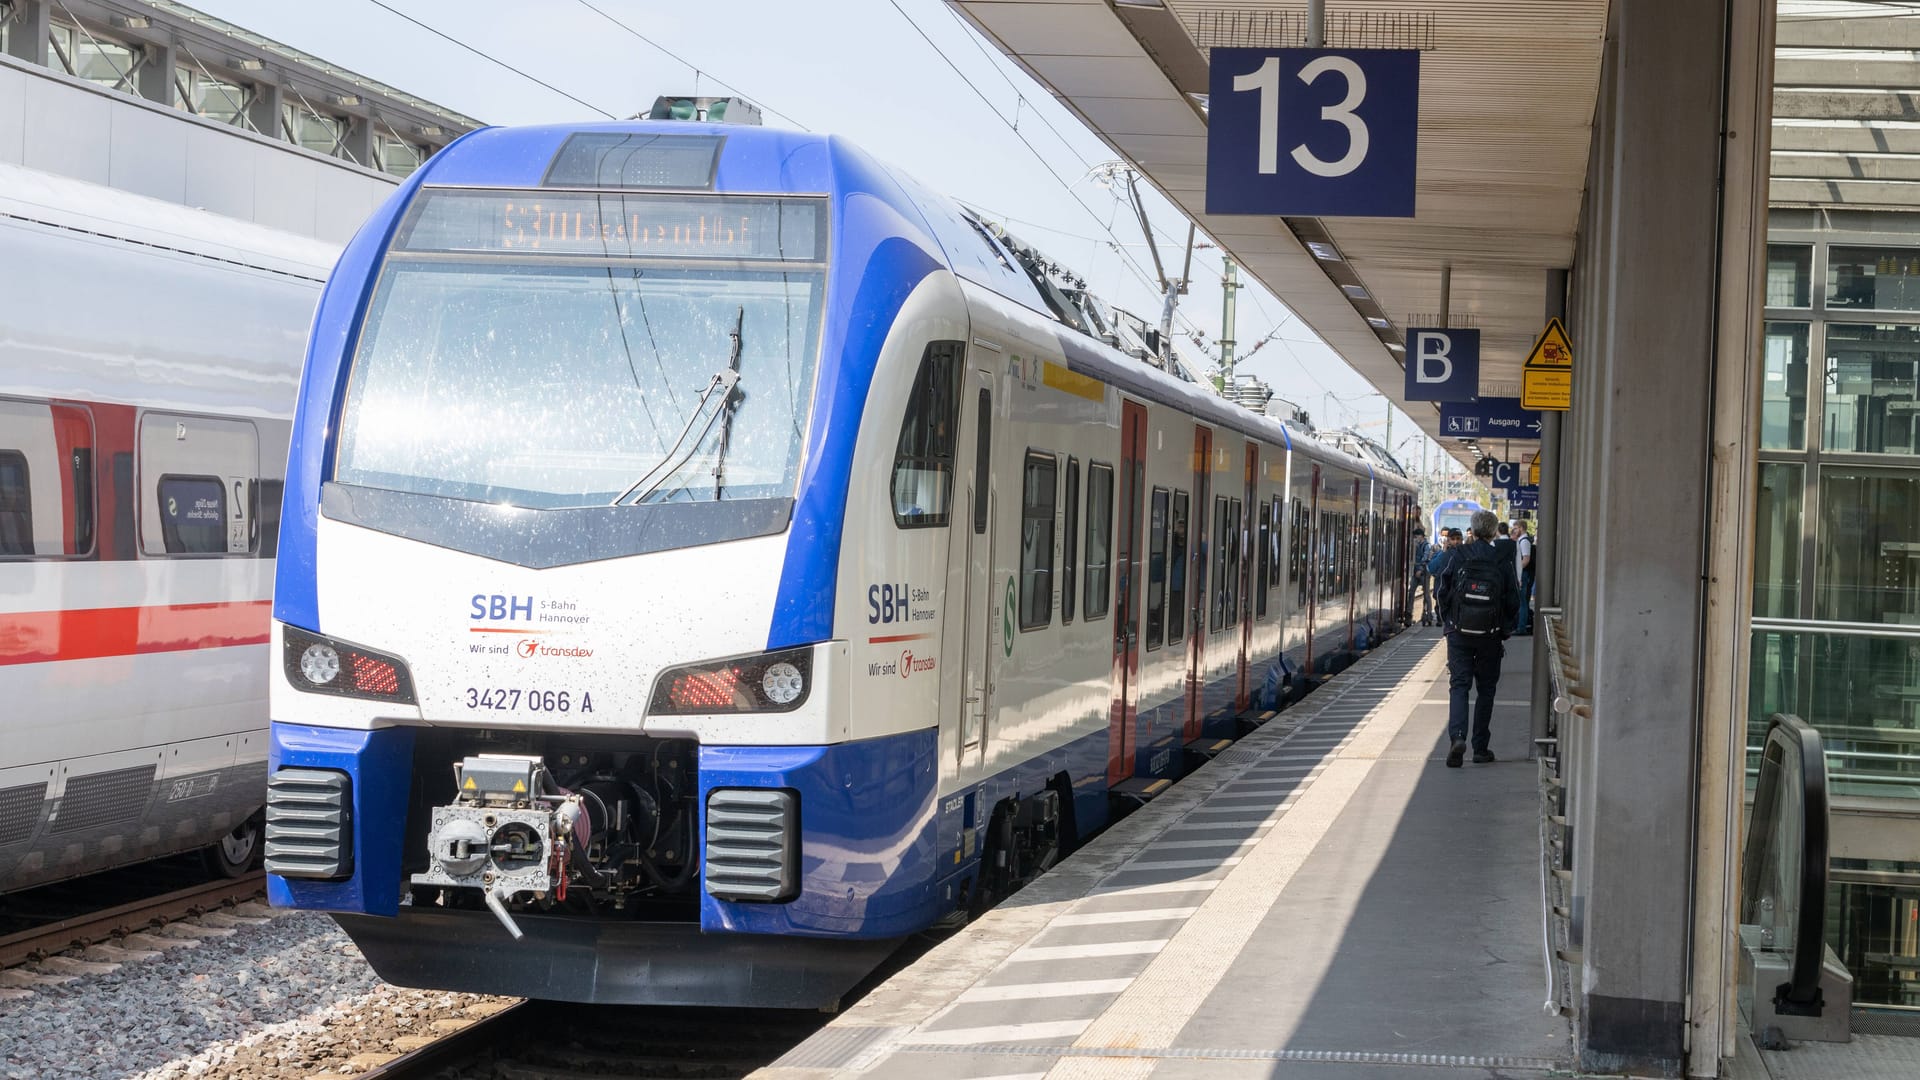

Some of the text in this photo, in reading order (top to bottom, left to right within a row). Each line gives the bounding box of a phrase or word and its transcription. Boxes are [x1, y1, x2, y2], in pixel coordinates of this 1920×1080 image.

[1233, 55, 1370, 178] 13
[1416, 331, 1453, 384] B
[1488, 417, 1521, 428] Ausgang
[1496, 462, 1511, 484] C
[540, 600, 576, 611] S-Bahn
[868, 583, 909, 625] SBH
[912, 589, 930, 602] S-Bahn
[470, 594, 533, 621] SBH
[912, 608, 936, 622] Hannover
[539, 613, 590, 624] Hannover
[469, 644, 594, 658] Wir sind transdev
[868, 655, 937, 677] Wir sind transdev
[466, 687, 593, 713] 3427 066 A
[945, 795, 965, 814] STADLER
